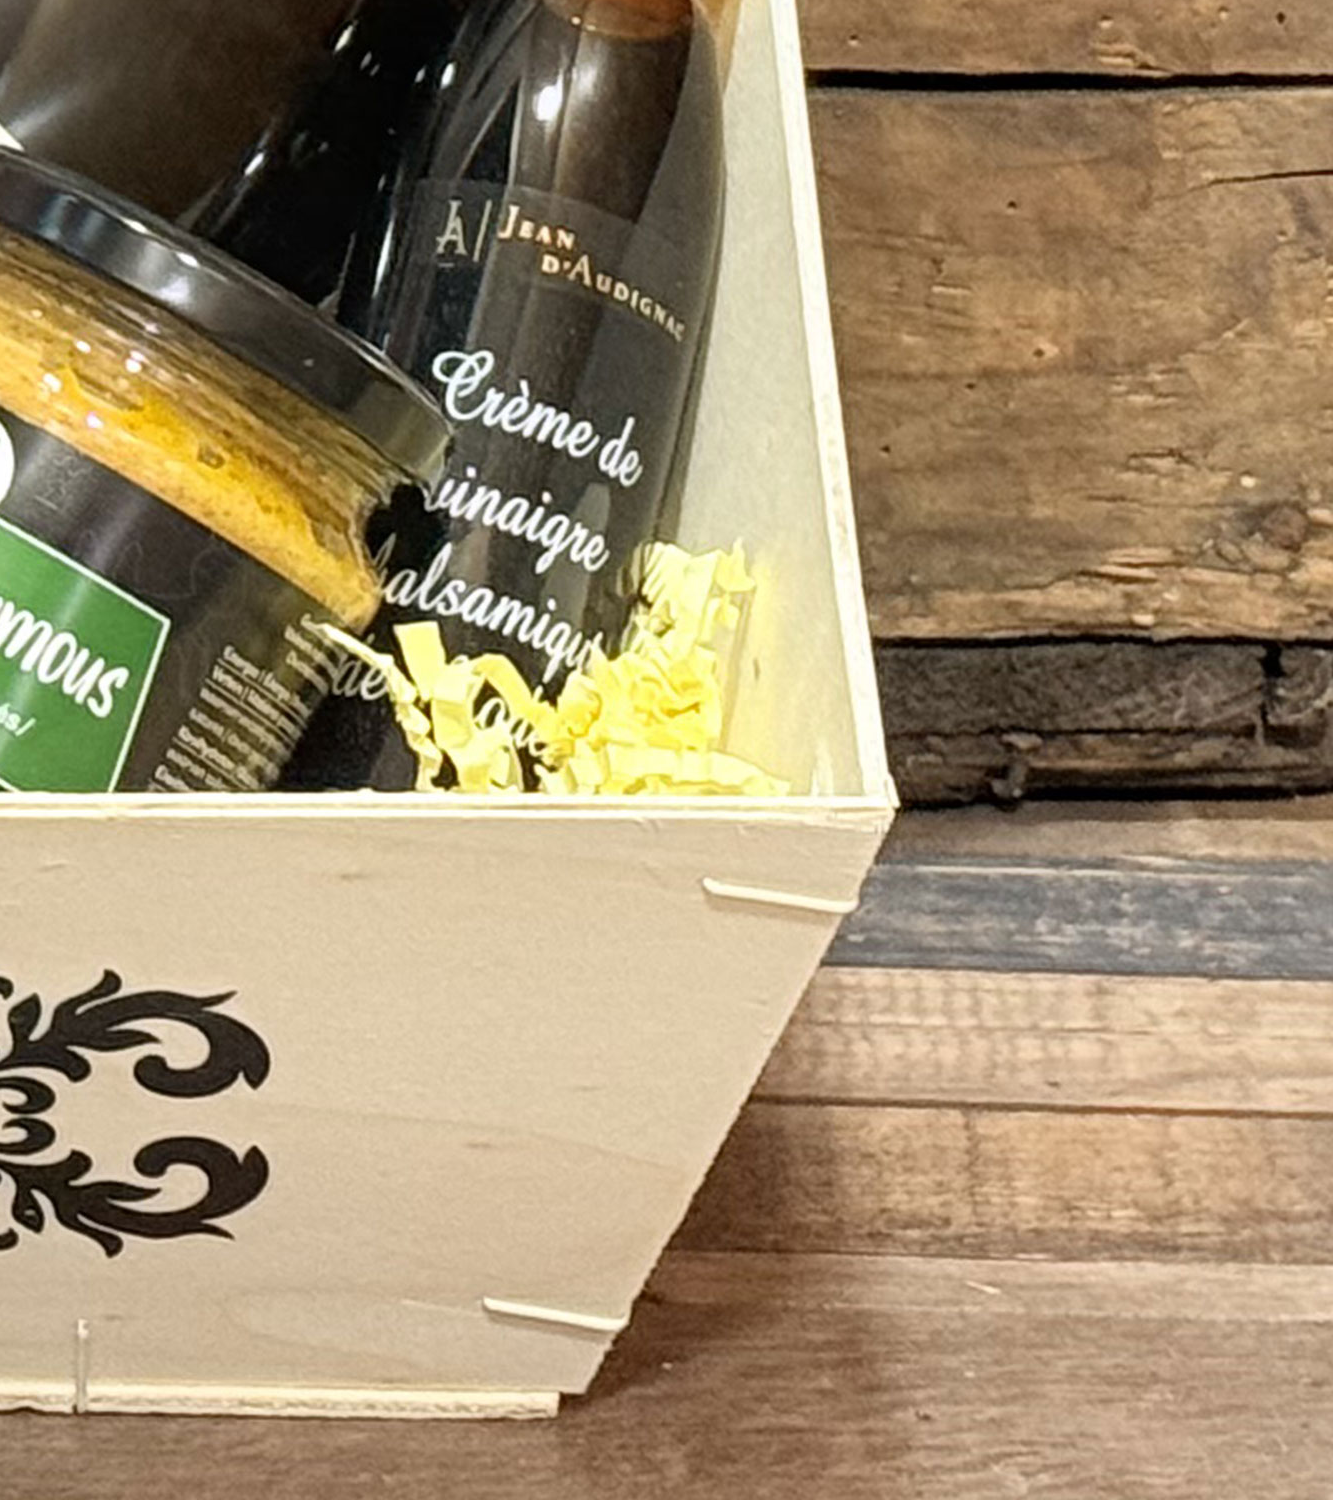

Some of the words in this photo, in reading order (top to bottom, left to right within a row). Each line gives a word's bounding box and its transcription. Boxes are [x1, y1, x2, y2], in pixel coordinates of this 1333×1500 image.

[433, 349, 599, 461] Crème
[599, 416, 644, 488] de
[424, 467, 609, 575] vinaigre
[368, 533, 603, 682] alsamiqu
